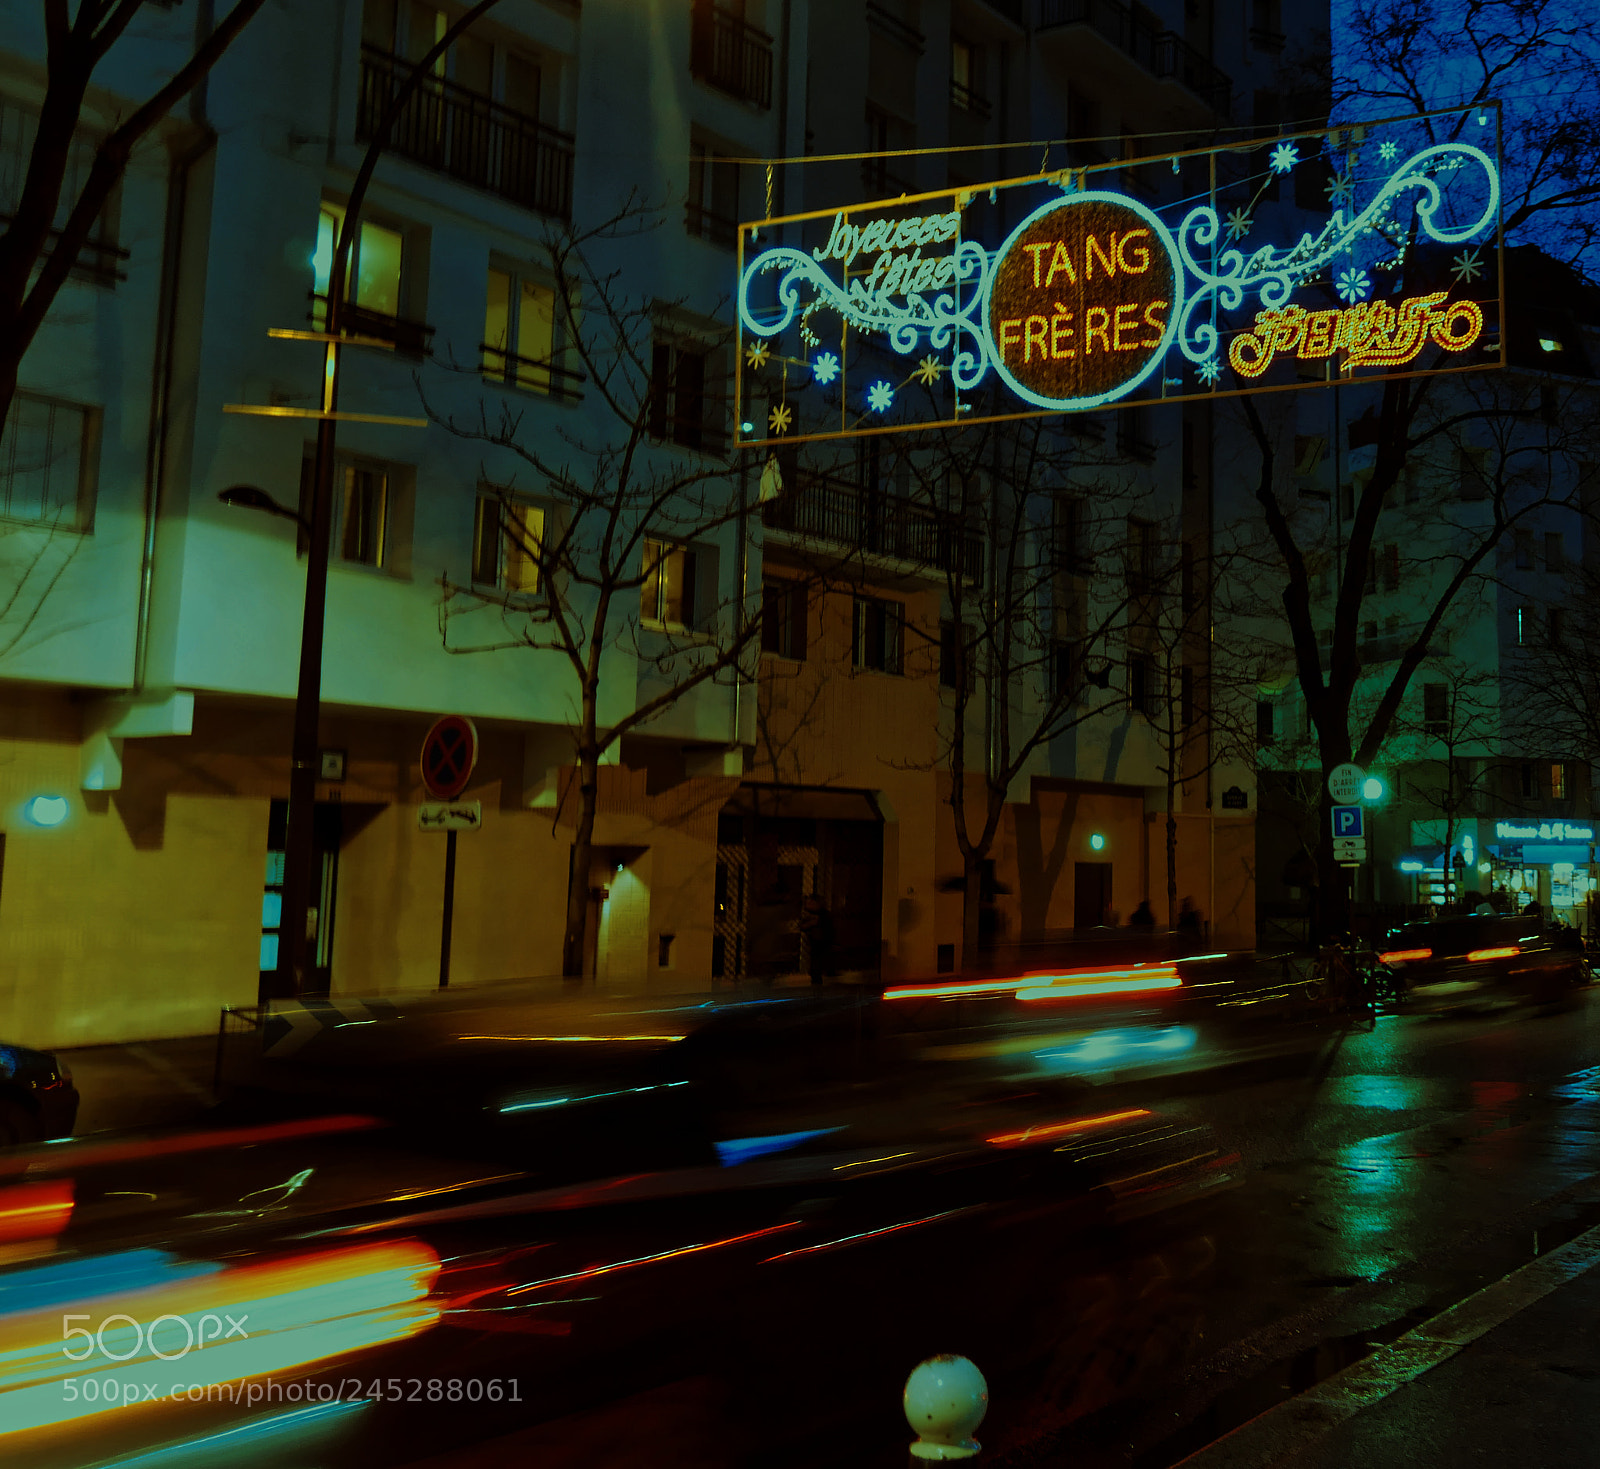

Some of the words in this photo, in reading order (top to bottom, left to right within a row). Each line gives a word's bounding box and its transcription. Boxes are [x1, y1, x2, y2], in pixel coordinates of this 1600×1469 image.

[813, 212, 961, 266] Joyeuses
[1022, 228, 1150, 288] TANG
[1000, 300, 1168, 364] FRÈRES
[1340, 811, 1355, 833] P
